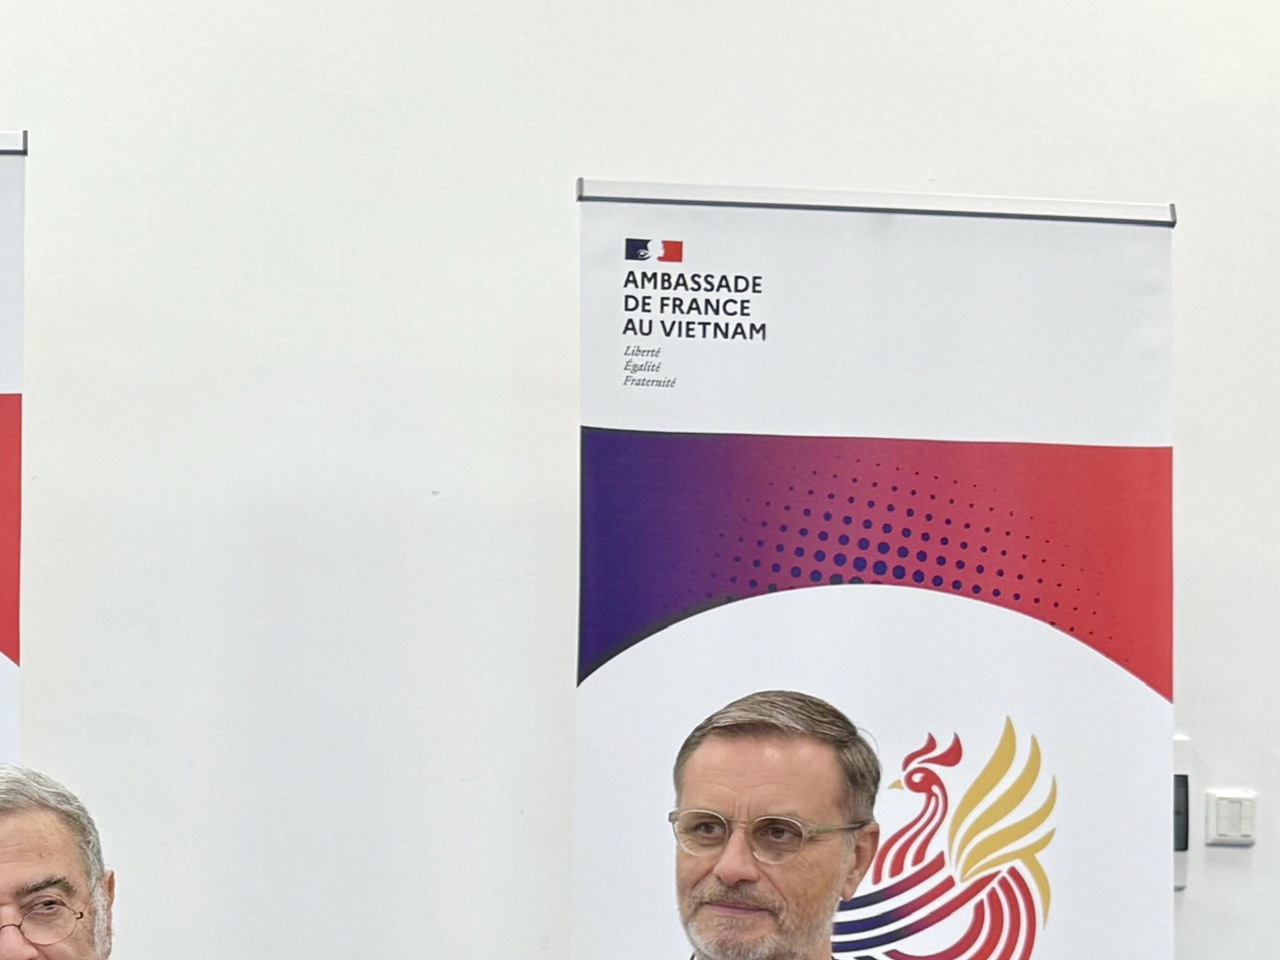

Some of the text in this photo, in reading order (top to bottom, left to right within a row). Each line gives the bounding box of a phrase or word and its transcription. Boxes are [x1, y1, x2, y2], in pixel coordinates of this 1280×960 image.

[623, 270, 763, 294] AMBASSADE
[623, 294, 751, 317] DE FRANCE
[622, 318, 767, 341] AU VIETNAM
[623, 345, 661, 358] Liberté
[623, 359, 662, 374] Égalité
[622, 375, 677, 389] Fraternité
